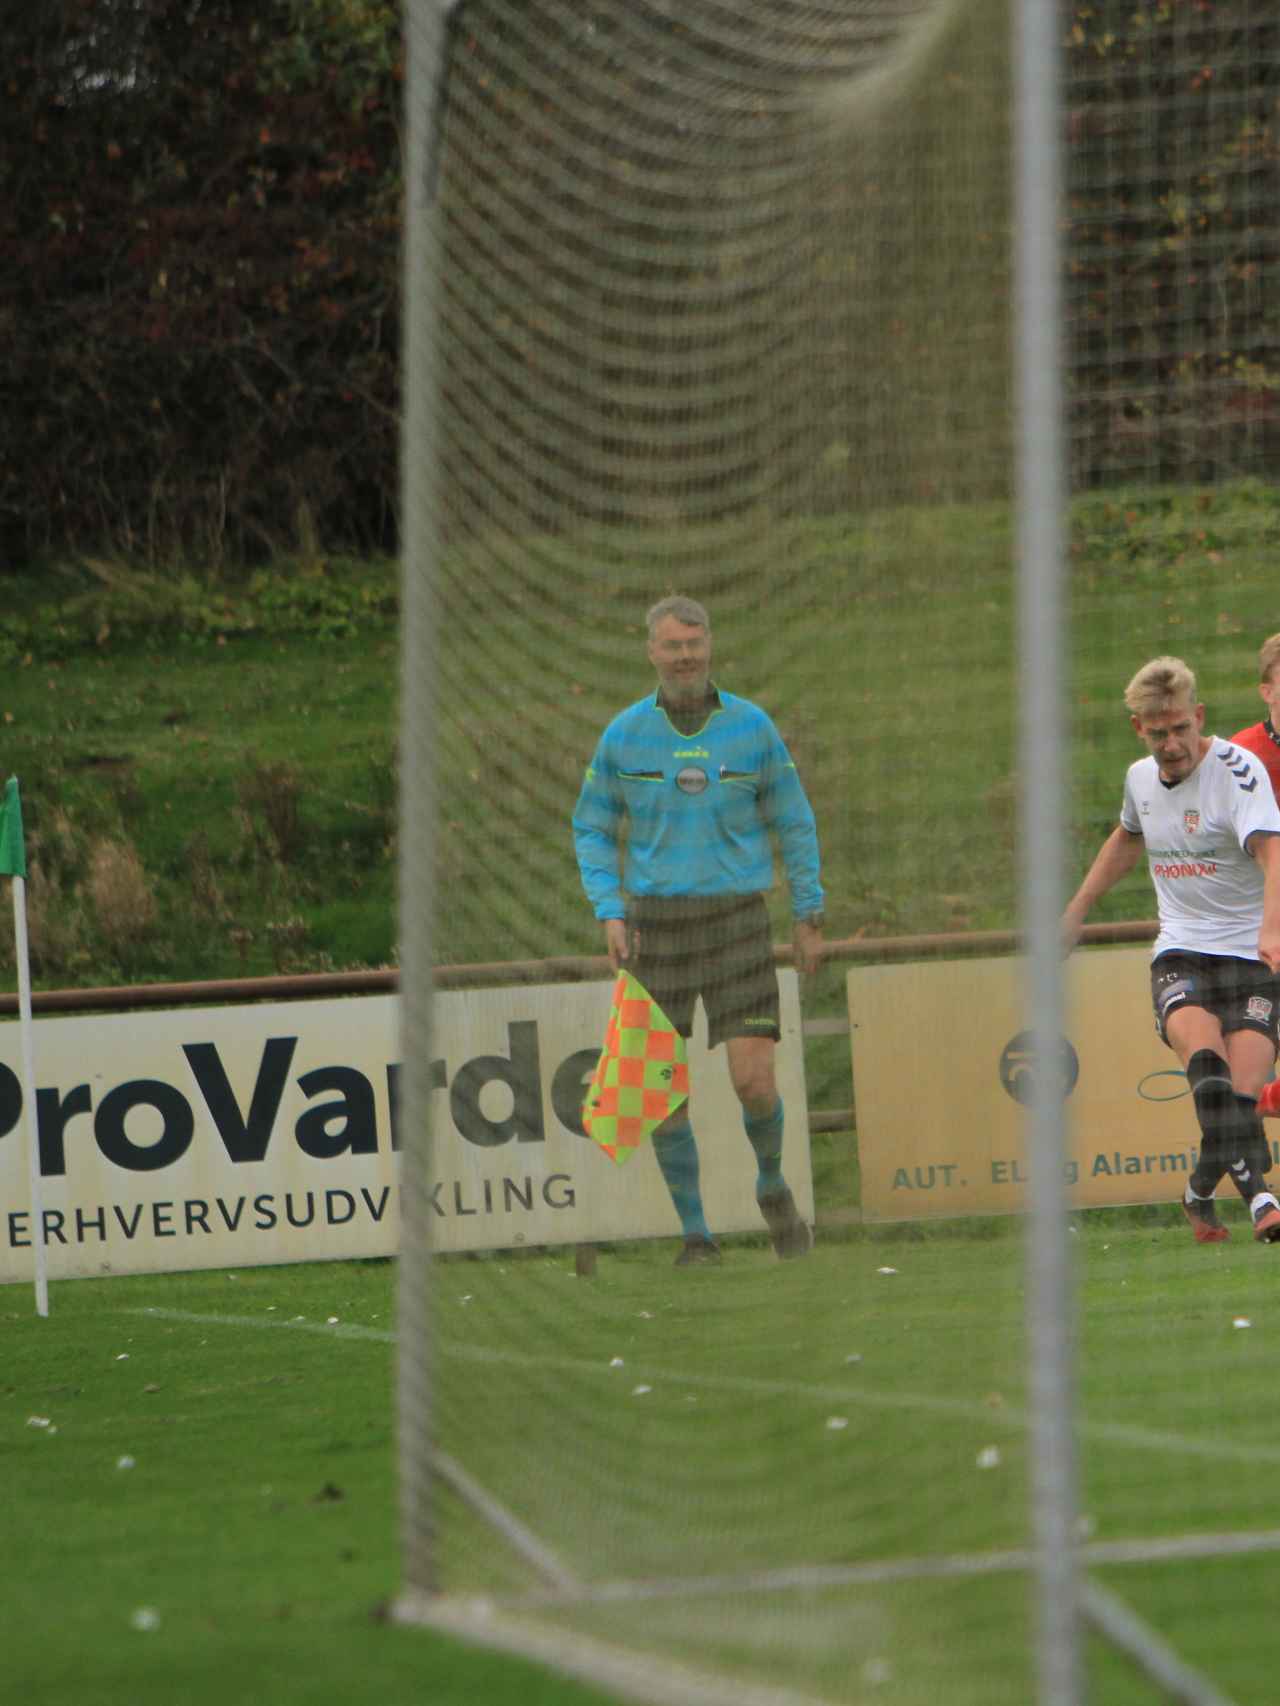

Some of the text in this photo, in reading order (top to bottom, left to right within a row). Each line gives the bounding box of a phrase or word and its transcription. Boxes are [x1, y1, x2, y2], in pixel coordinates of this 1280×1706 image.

[0, 1020, 604, 1177] roVard
[8, 1173, 577, 1248] ERHVERVSUDVKLING
[892, 1164, 968, 1190] AUT.
